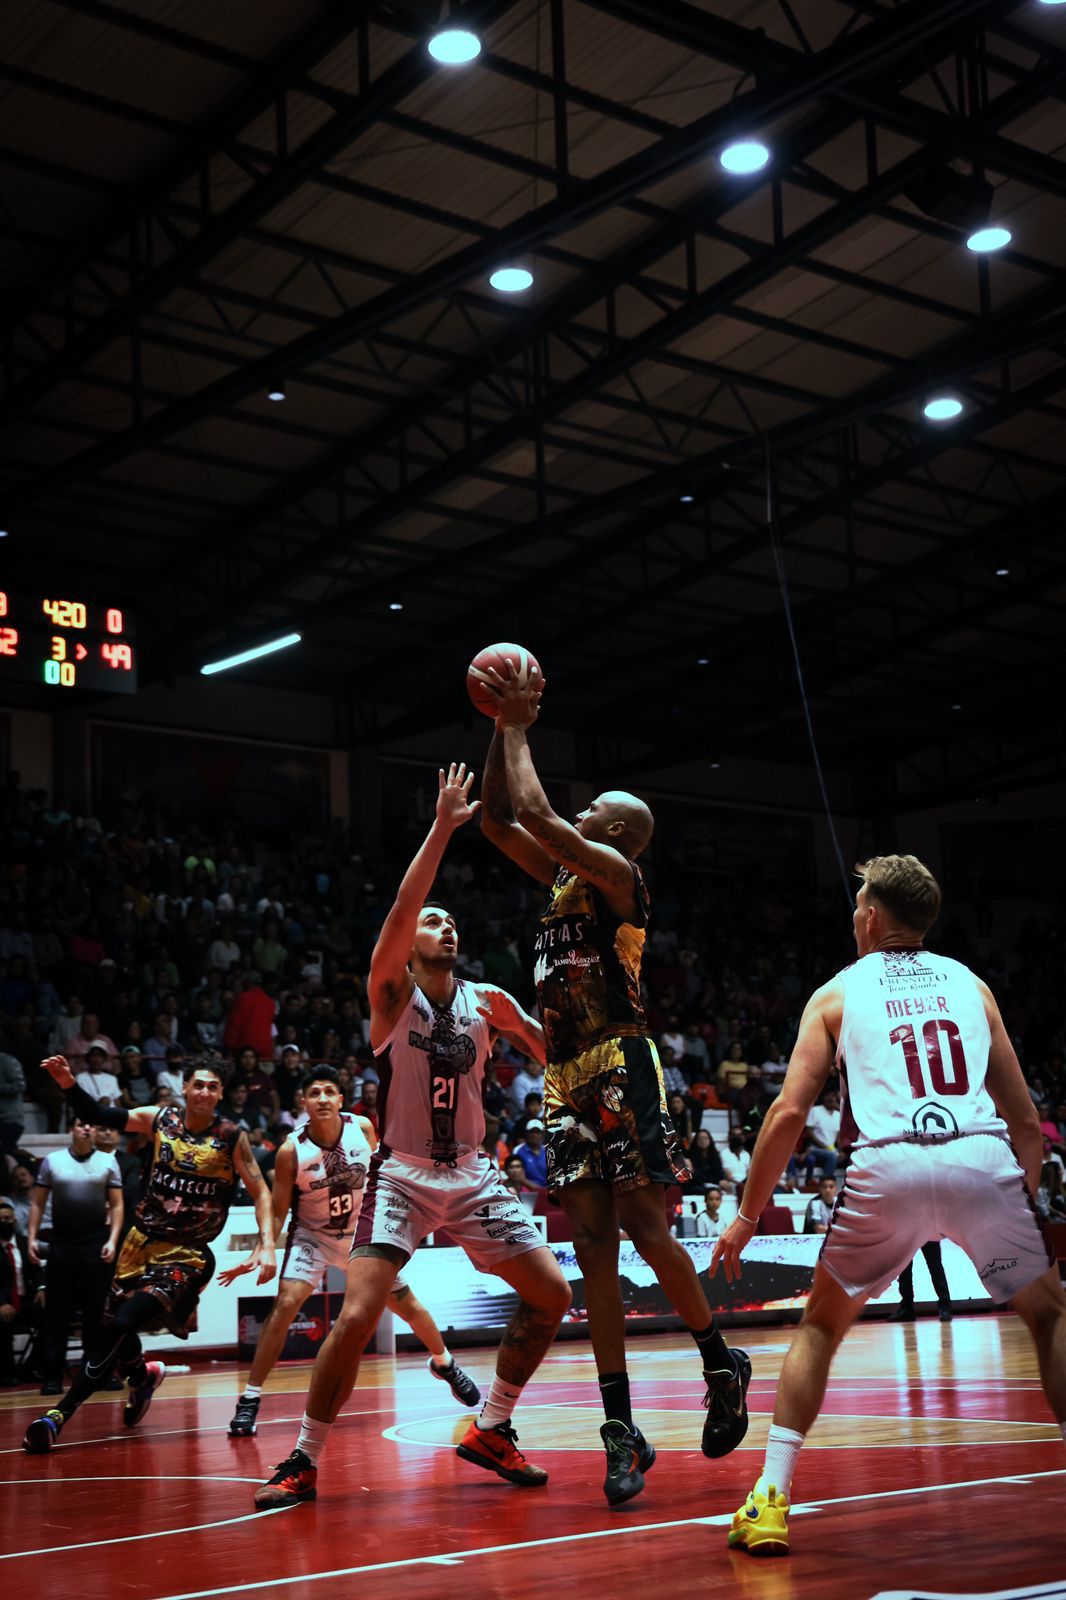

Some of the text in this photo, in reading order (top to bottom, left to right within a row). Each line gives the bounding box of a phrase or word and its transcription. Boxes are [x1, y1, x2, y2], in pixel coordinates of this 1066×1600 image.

[106, 608, 123, 634] 0
[101, 643, 132, 670] 49
[44, 660, 76, 687] 00
[886, 996, 949, 1019] MEYER
[889, 1018, 970, 1099] 10
[433, 1076, 455, 1110] 21
[152, 1168, 217, 1196] ZACATECAS
[329, 1193, 352, 1217] 33
